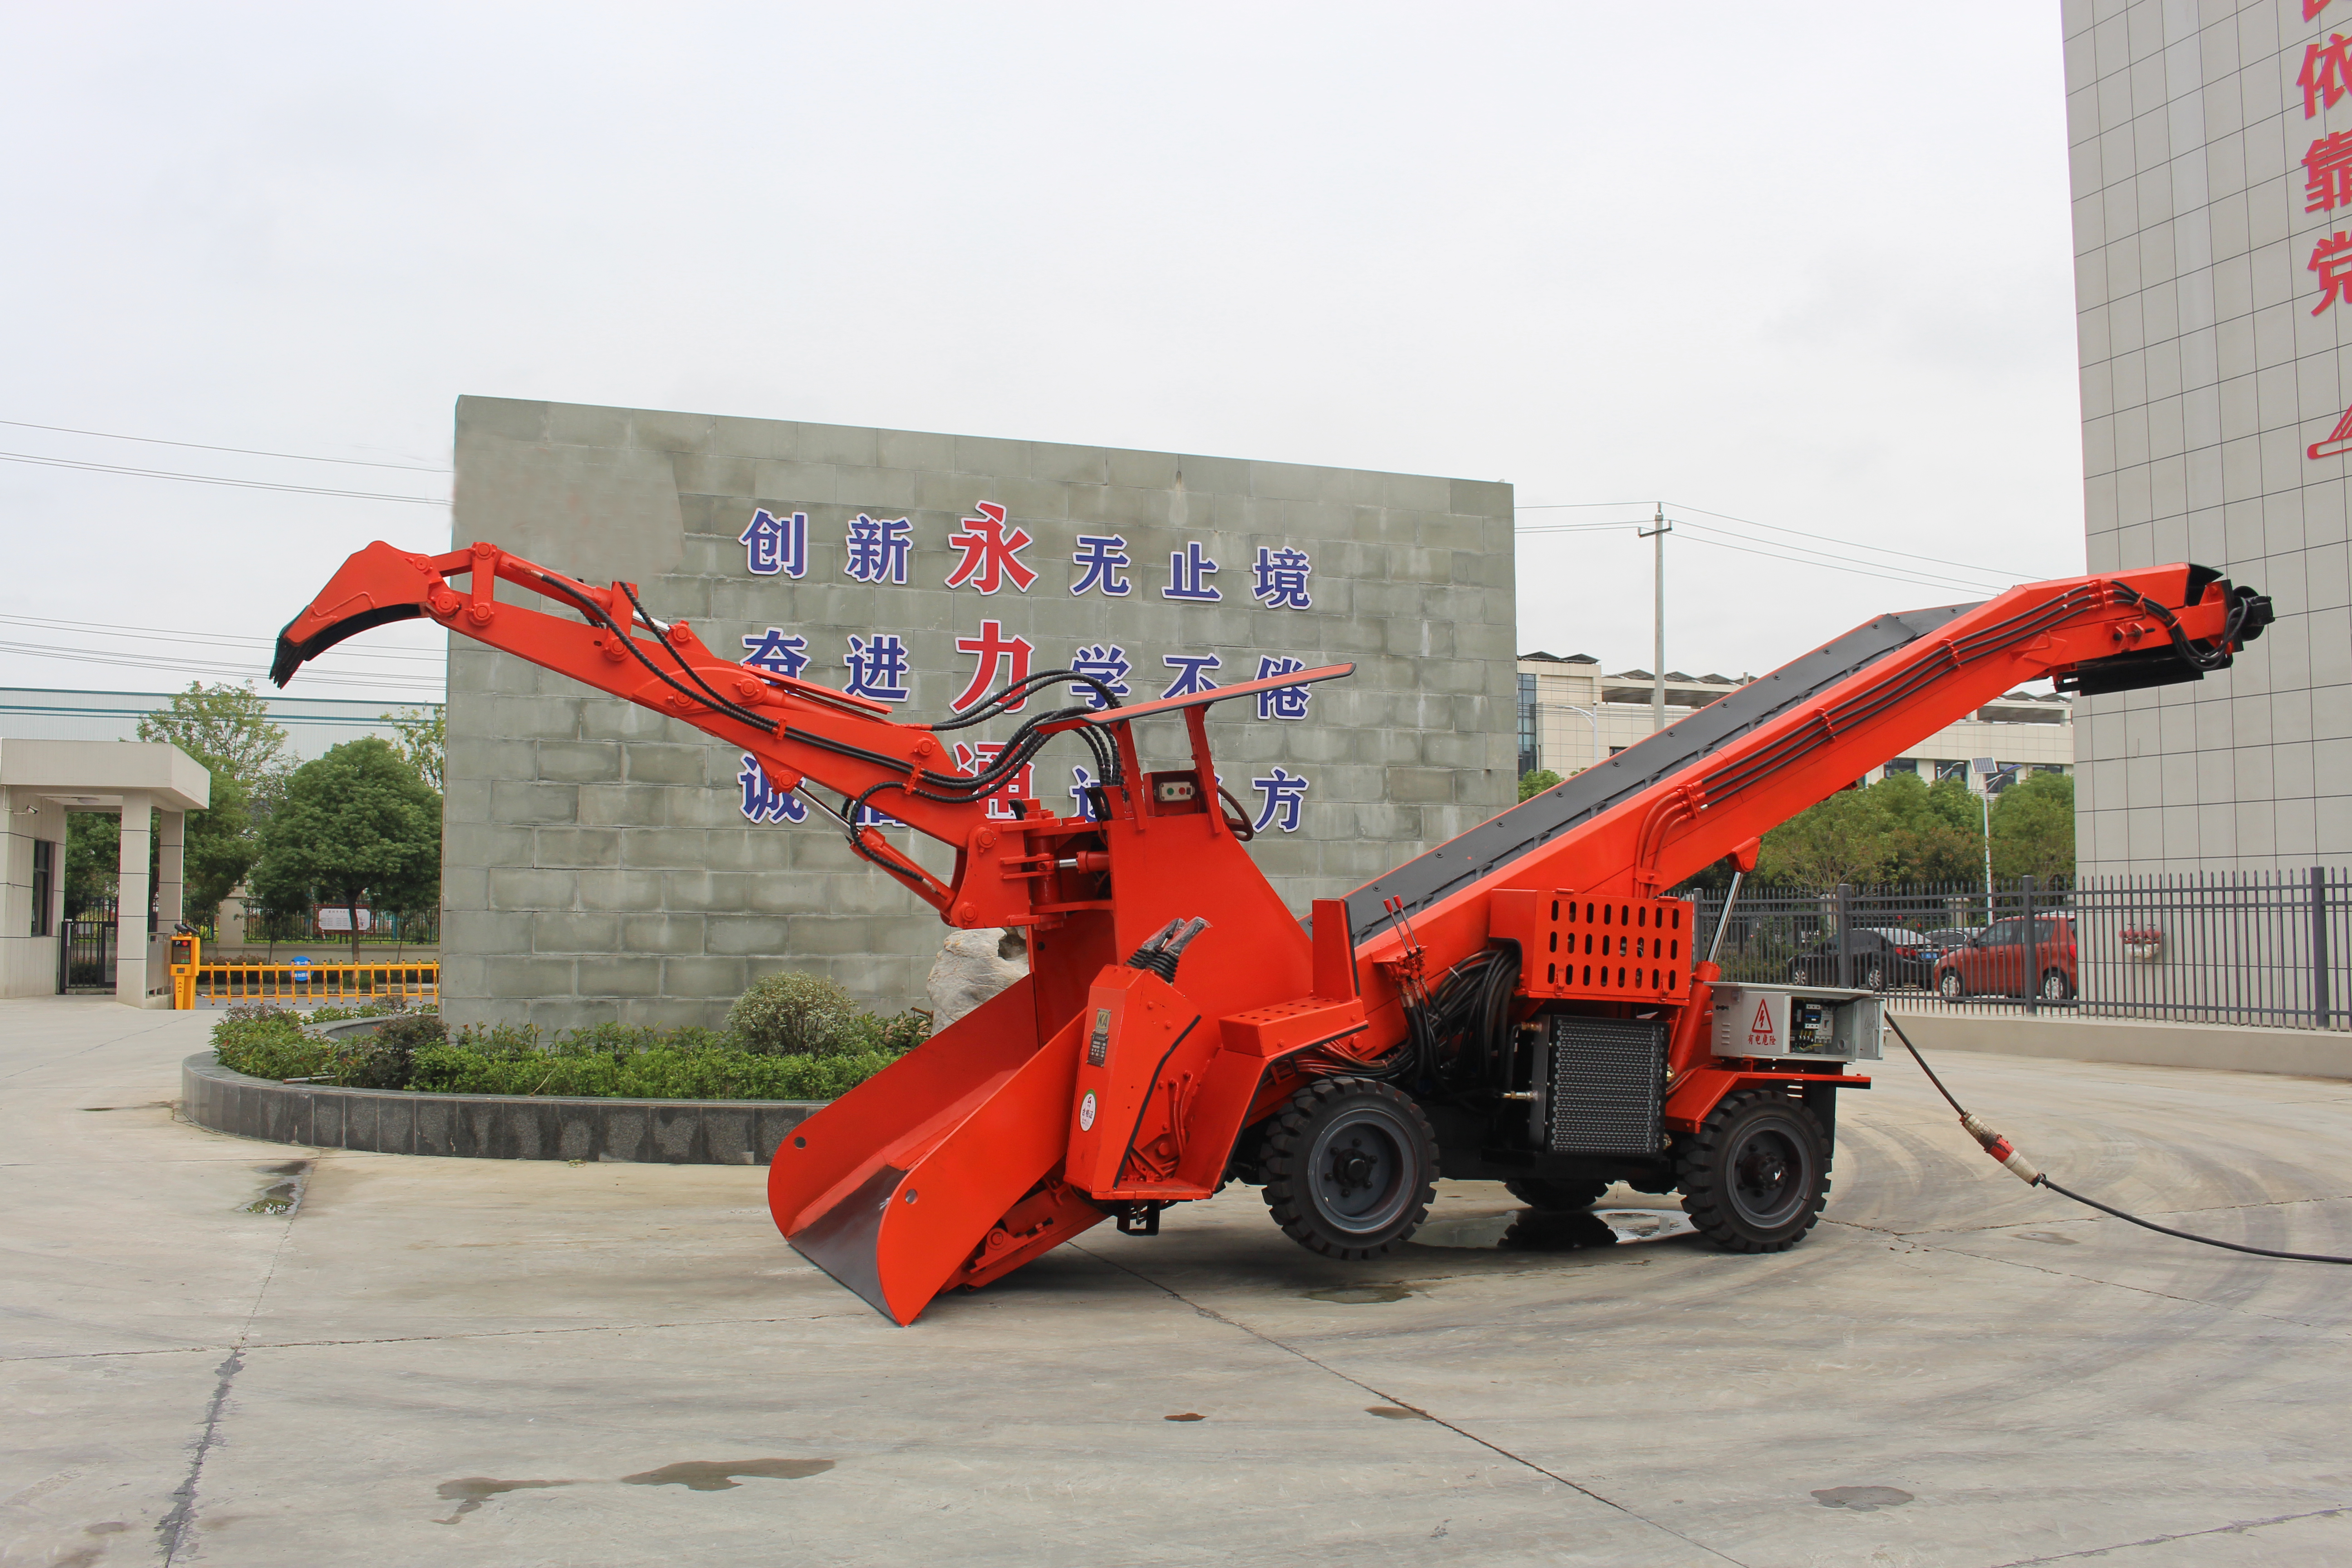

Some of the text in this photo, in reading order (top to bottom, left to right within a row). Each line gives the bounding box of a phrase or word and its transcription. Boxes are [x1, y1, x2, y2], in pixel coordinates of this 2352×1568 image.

[738, 500, 1312, 610] 创新永无止境
[740, 619, 1312, 720] 奋进力学不倦
[1097, 1014, 1108, 1027] KA
[1748, 1033, 1776, 1045] 有电危险
[1082, 1107, 1093, 1119] 合格证
